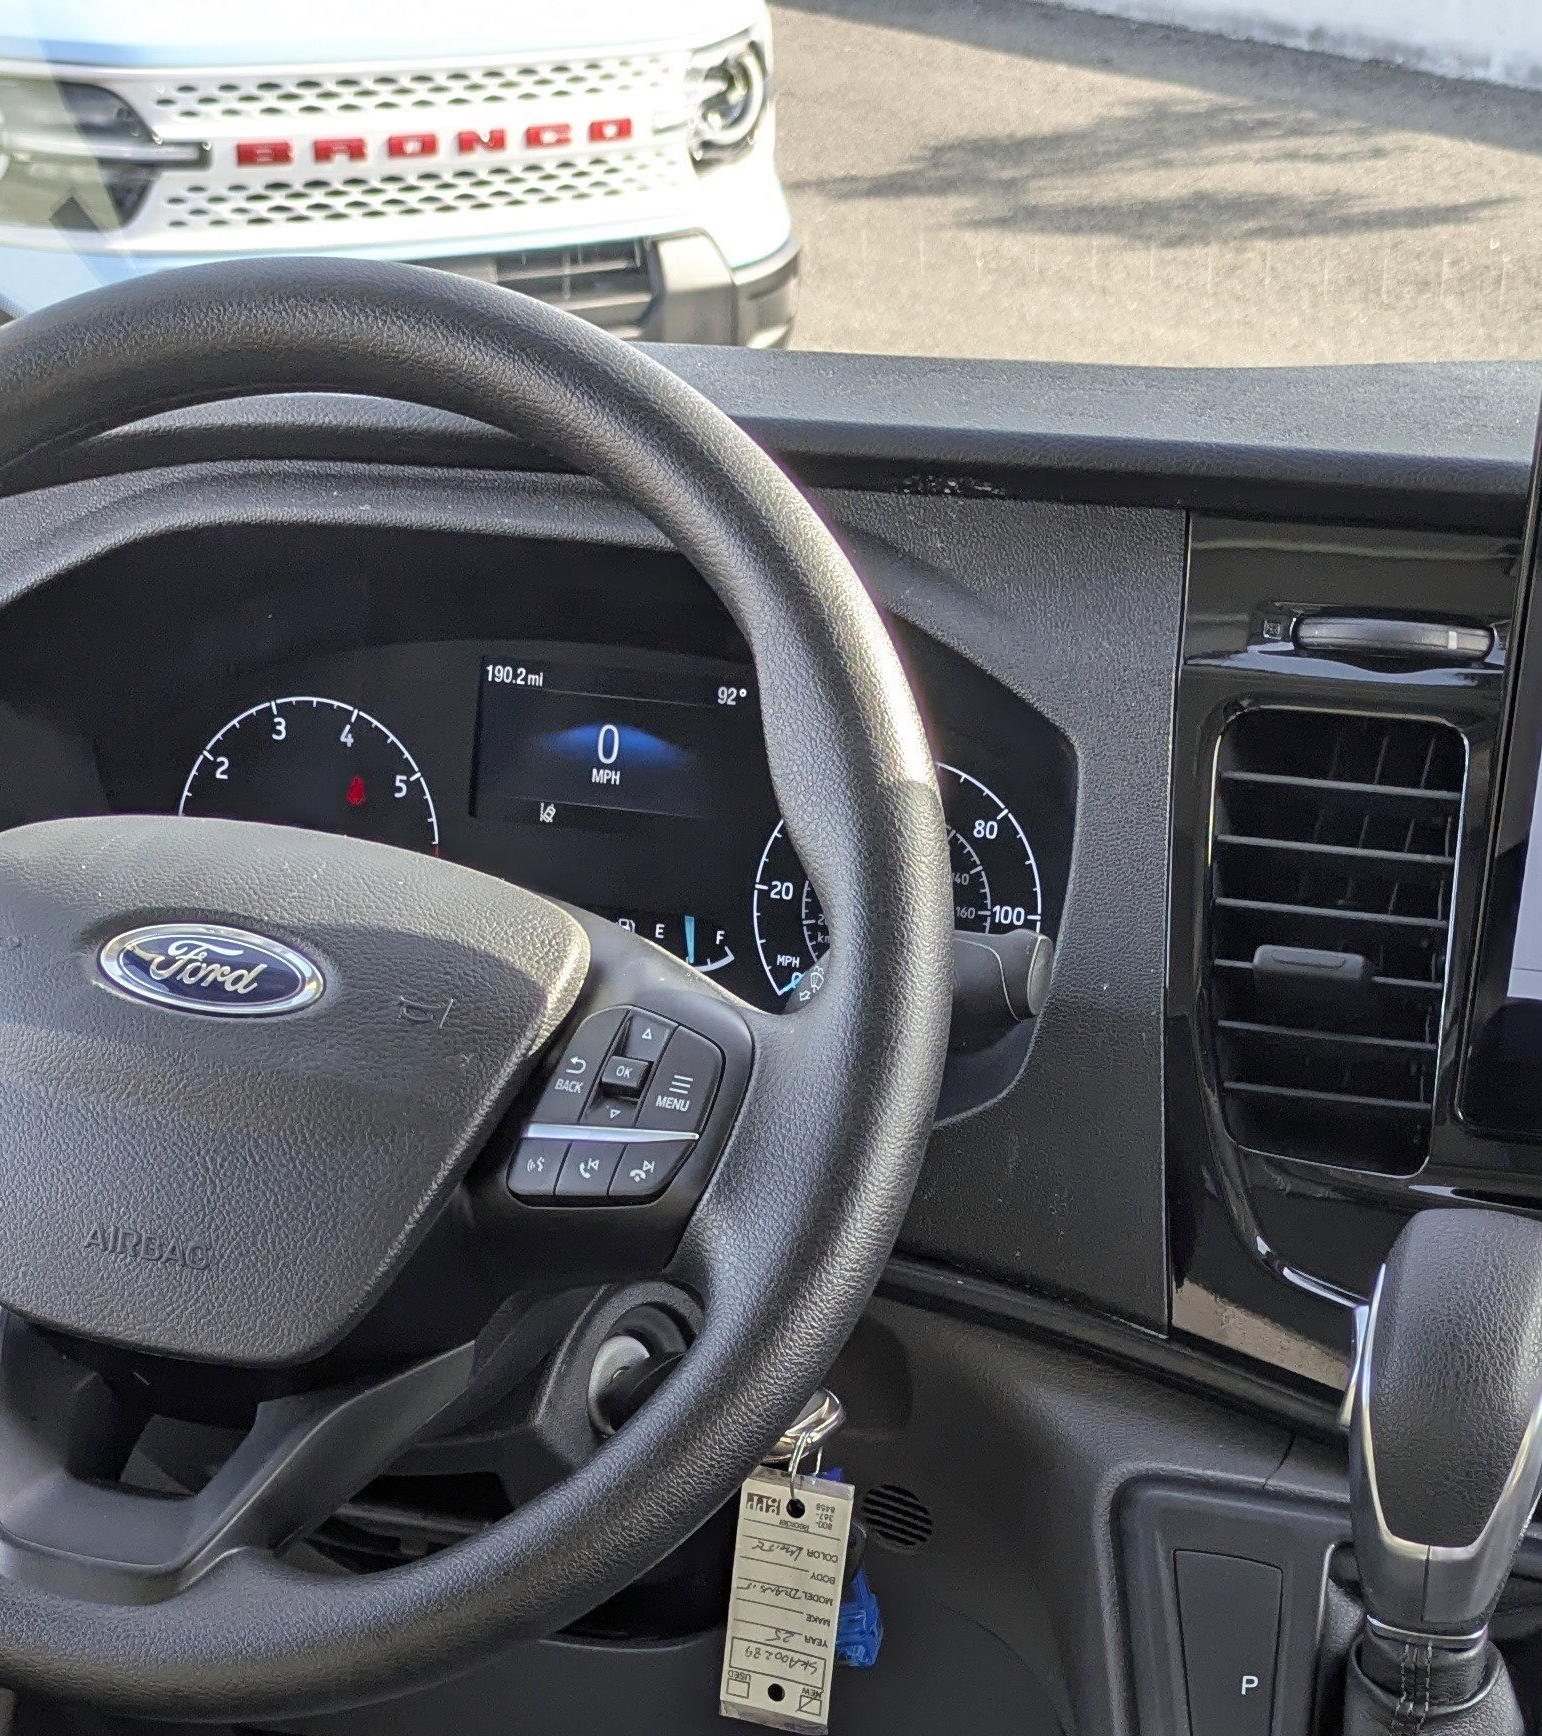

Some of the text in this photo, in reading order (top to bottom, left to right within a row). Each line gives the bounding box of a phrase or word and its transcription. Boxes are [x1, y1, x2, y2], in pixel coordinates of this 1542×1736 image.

[237, 119, 631, 166] BRONCO
[486, 665, 526, 685] 190.2
[717, 687, 747, 705] 92°
[272, 717, 287, 740] 3
[340, 724, 354, 747] 4
[597, 724, 620, 764] 0
[215, 757, 230, 779] 2
[591, 769, 620, 785] MPH
[394, 775, 408, 798] 5
[973, 820, 998, 839] 80
[770, 881, 793, 900] 20
[955, 907, 975, 919] 160
[992, 906, 1025, 925] 100
[655, 924, 665, 939] E
[716, 930, 725, 945] F
[134, 939, 268, 995] Ford
[776, 955, 800, 968] MPH
[615, 1066, 633, 1079] OK
[555, 1079, 584, 1093] BACK
[655, 1095, 690, 1112] MENU
[84, 1222, 209, 1270] AIRBAG
[806, 1548, 839, 1563] COLOR
[810, 1572, 836, 1585] BODY
[802, 1590, 834, 1606] MODEL
[806, 1613, 831, 1627] MAKE
[804, 1635, 828, 1649] YEAR
[728, 1669, 751, 1681] USED
[801, 1687, 823, 1699] NEW
[1241, 1676, 1258, 1696] P
